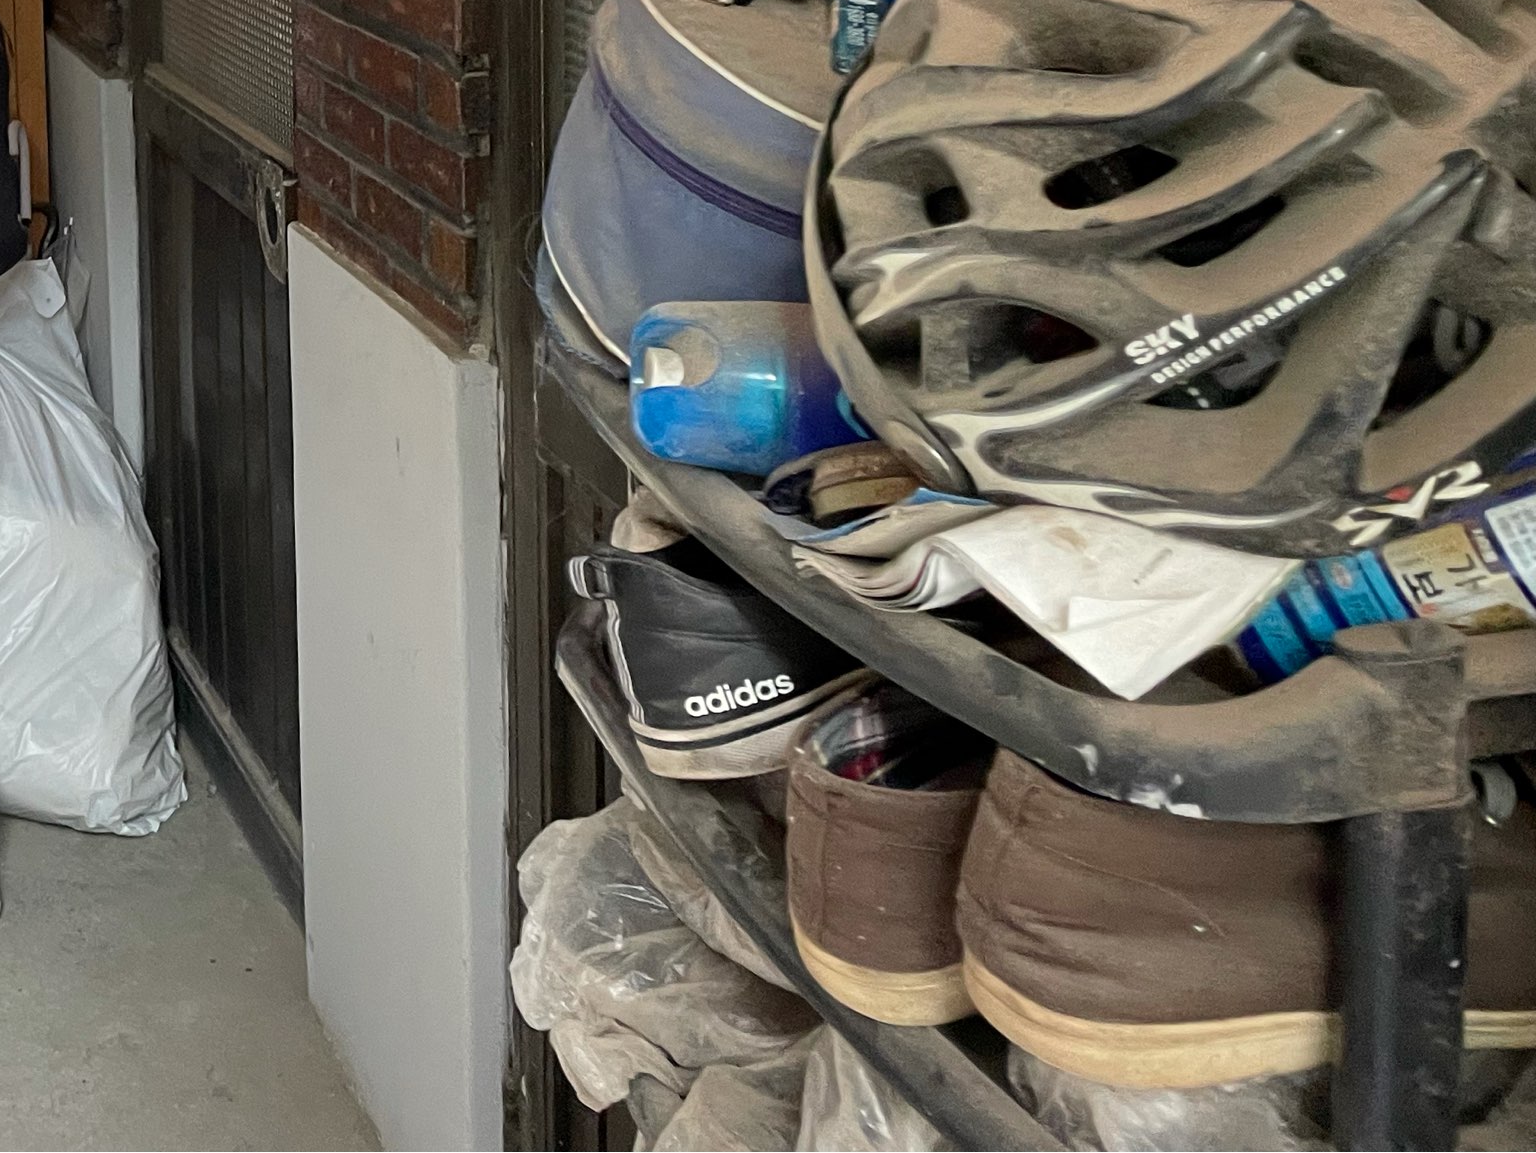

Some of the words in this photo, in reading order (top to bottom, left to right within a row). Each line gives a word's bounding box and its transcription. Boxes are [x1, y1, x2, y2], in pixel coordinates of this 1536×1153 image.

[1124, 313, 1200, 365] SKY
[1151, 345, 1212, 384] DESIGN
[1208, 266, 1347, 351] PERFORMANCE
[684, 674, 795, 717] adidas
